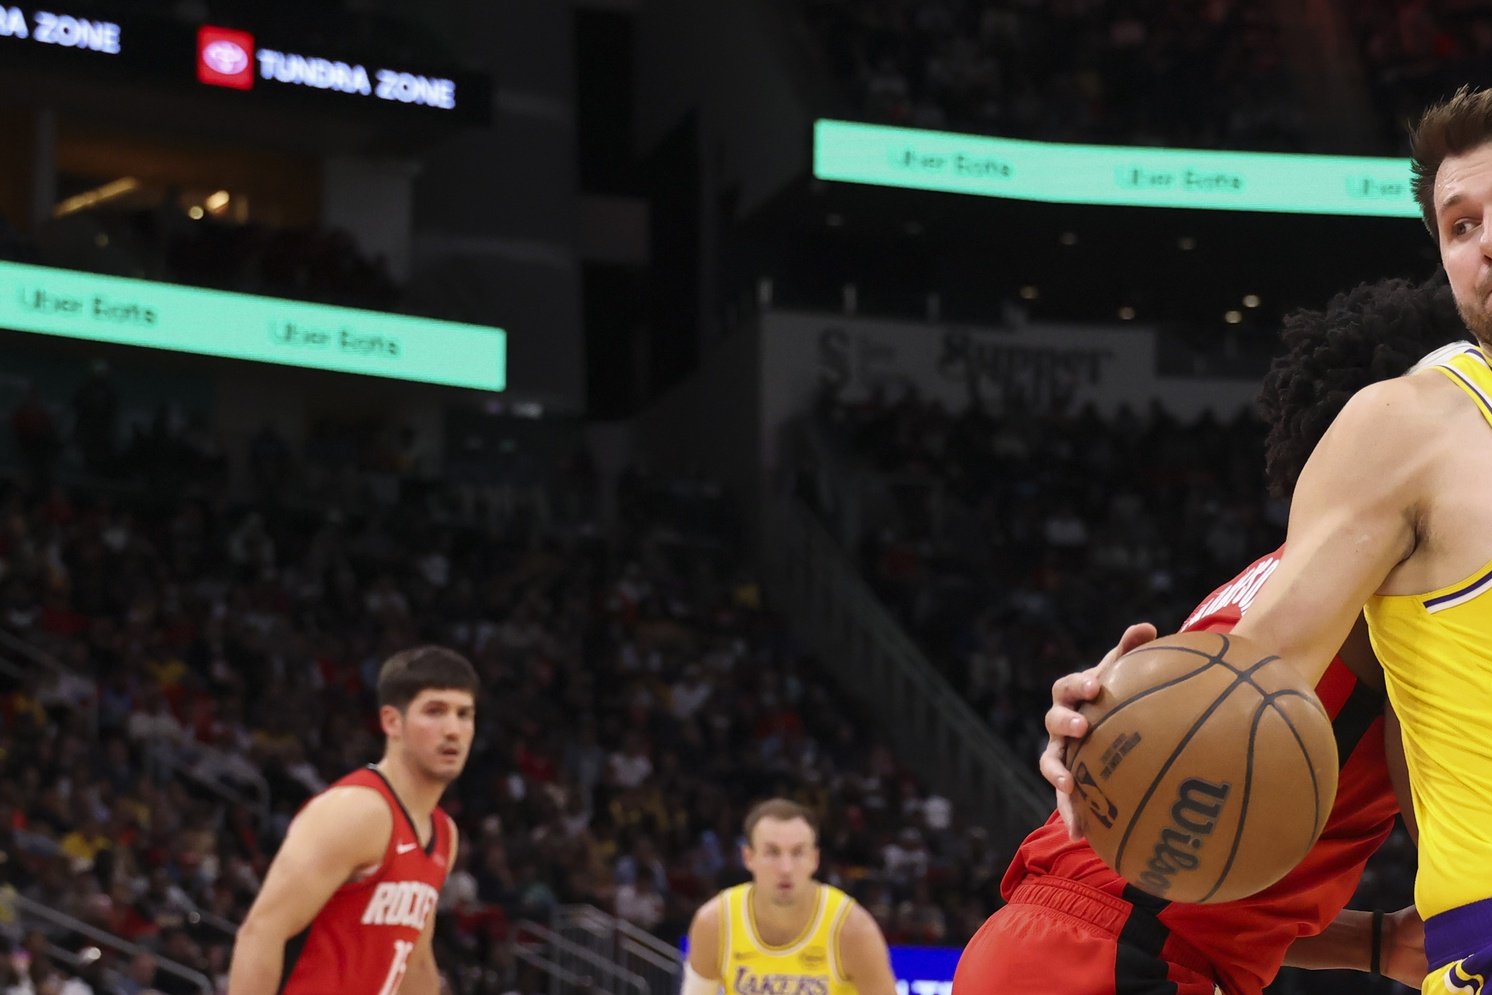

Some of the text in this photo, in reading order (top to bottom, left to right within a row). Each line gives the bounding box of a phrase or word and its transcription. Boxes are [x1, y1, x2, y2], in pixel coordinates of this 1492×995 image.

[33, 9, 121, 54] ZONE
[256, 48, 456, 110] TUNDRA ZONE
